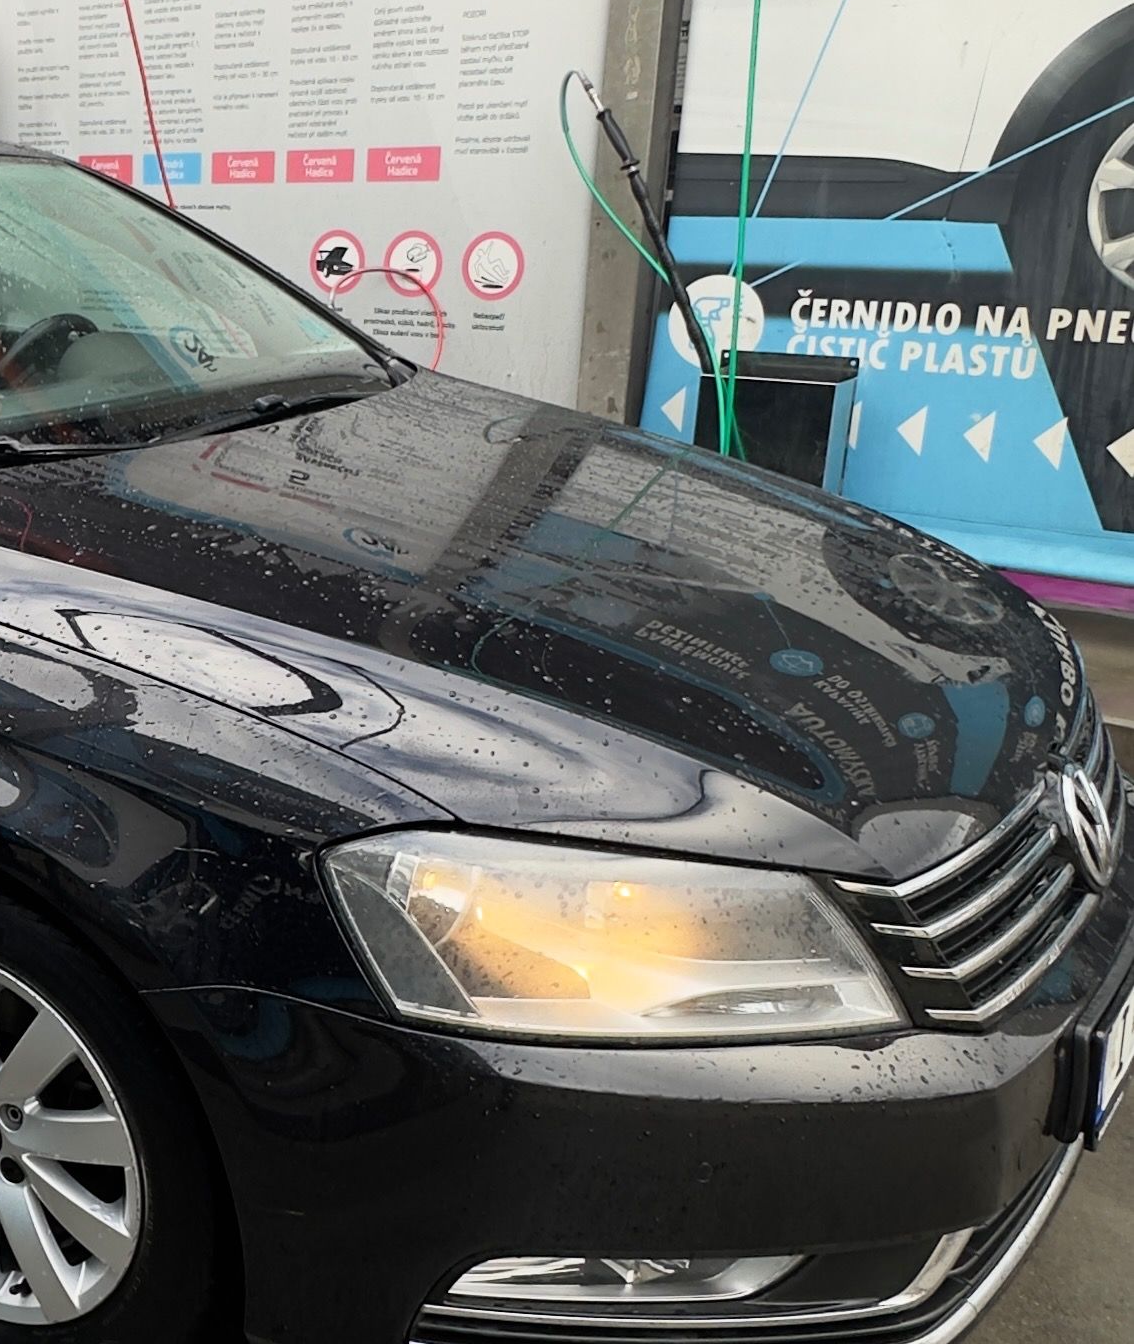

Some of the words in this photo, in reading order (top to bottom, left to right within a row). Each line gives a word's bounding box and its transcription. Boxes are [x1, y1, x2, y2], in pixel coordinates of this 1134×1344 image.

[226, 155, 259, 168] Červená
[302, 153, 337, 167] Červená
[385, 150, 422, 166] Červená
[228, 168, 257, 179] Hadice
[304, 167, 335, 179] Hadice
[386, 166, 419, 178] Hadice
[790, 289, 962, 337] ČERNIDLO
[974, 304, 1032, 339] NA
[1045, 308, 1134, 344] PNE
[899, 338, 1037, 380] PLASTŮ
